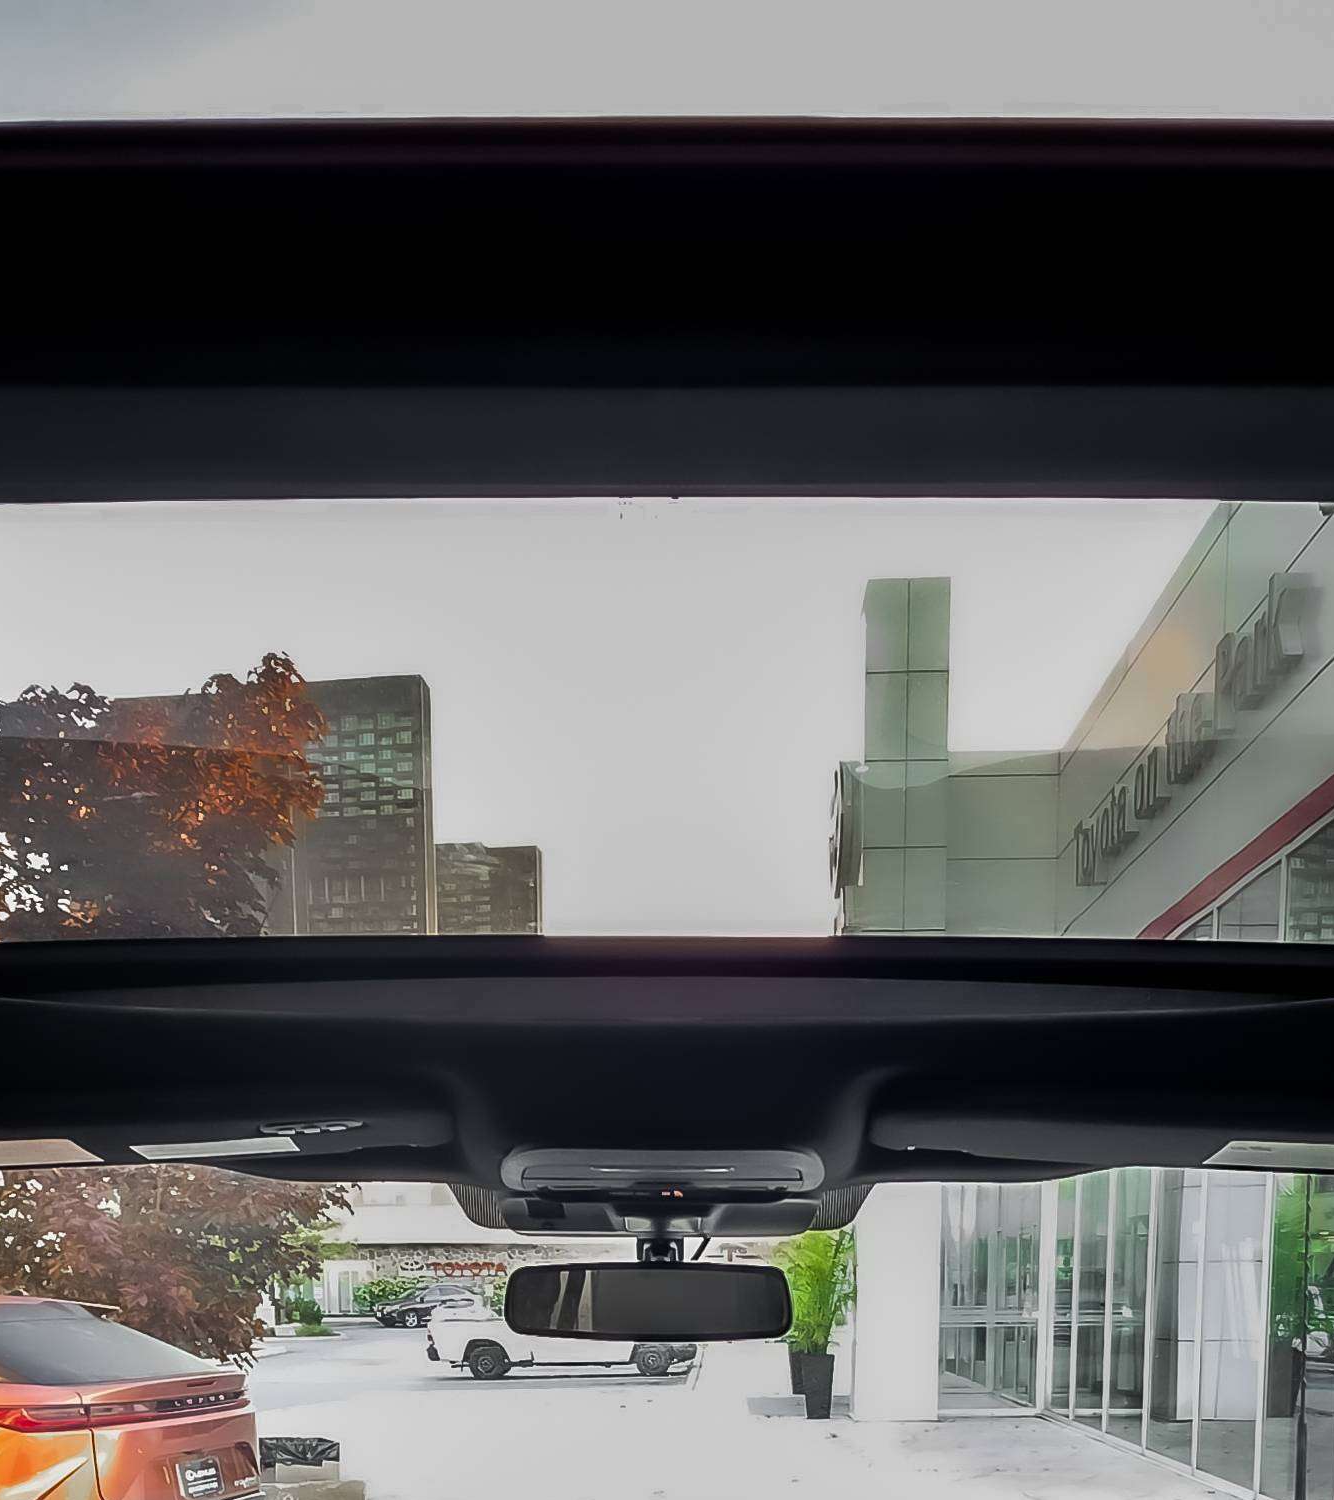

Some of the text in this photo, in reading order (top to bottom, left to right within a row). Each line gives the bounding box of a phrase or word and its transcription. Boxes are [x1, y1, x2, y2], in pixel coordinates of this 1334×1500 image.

[1074, 784, 1139, 886] Toyota
[1134, 746, 1171, 820] on
[427, 1261, 508, 1280] TOYOTA
